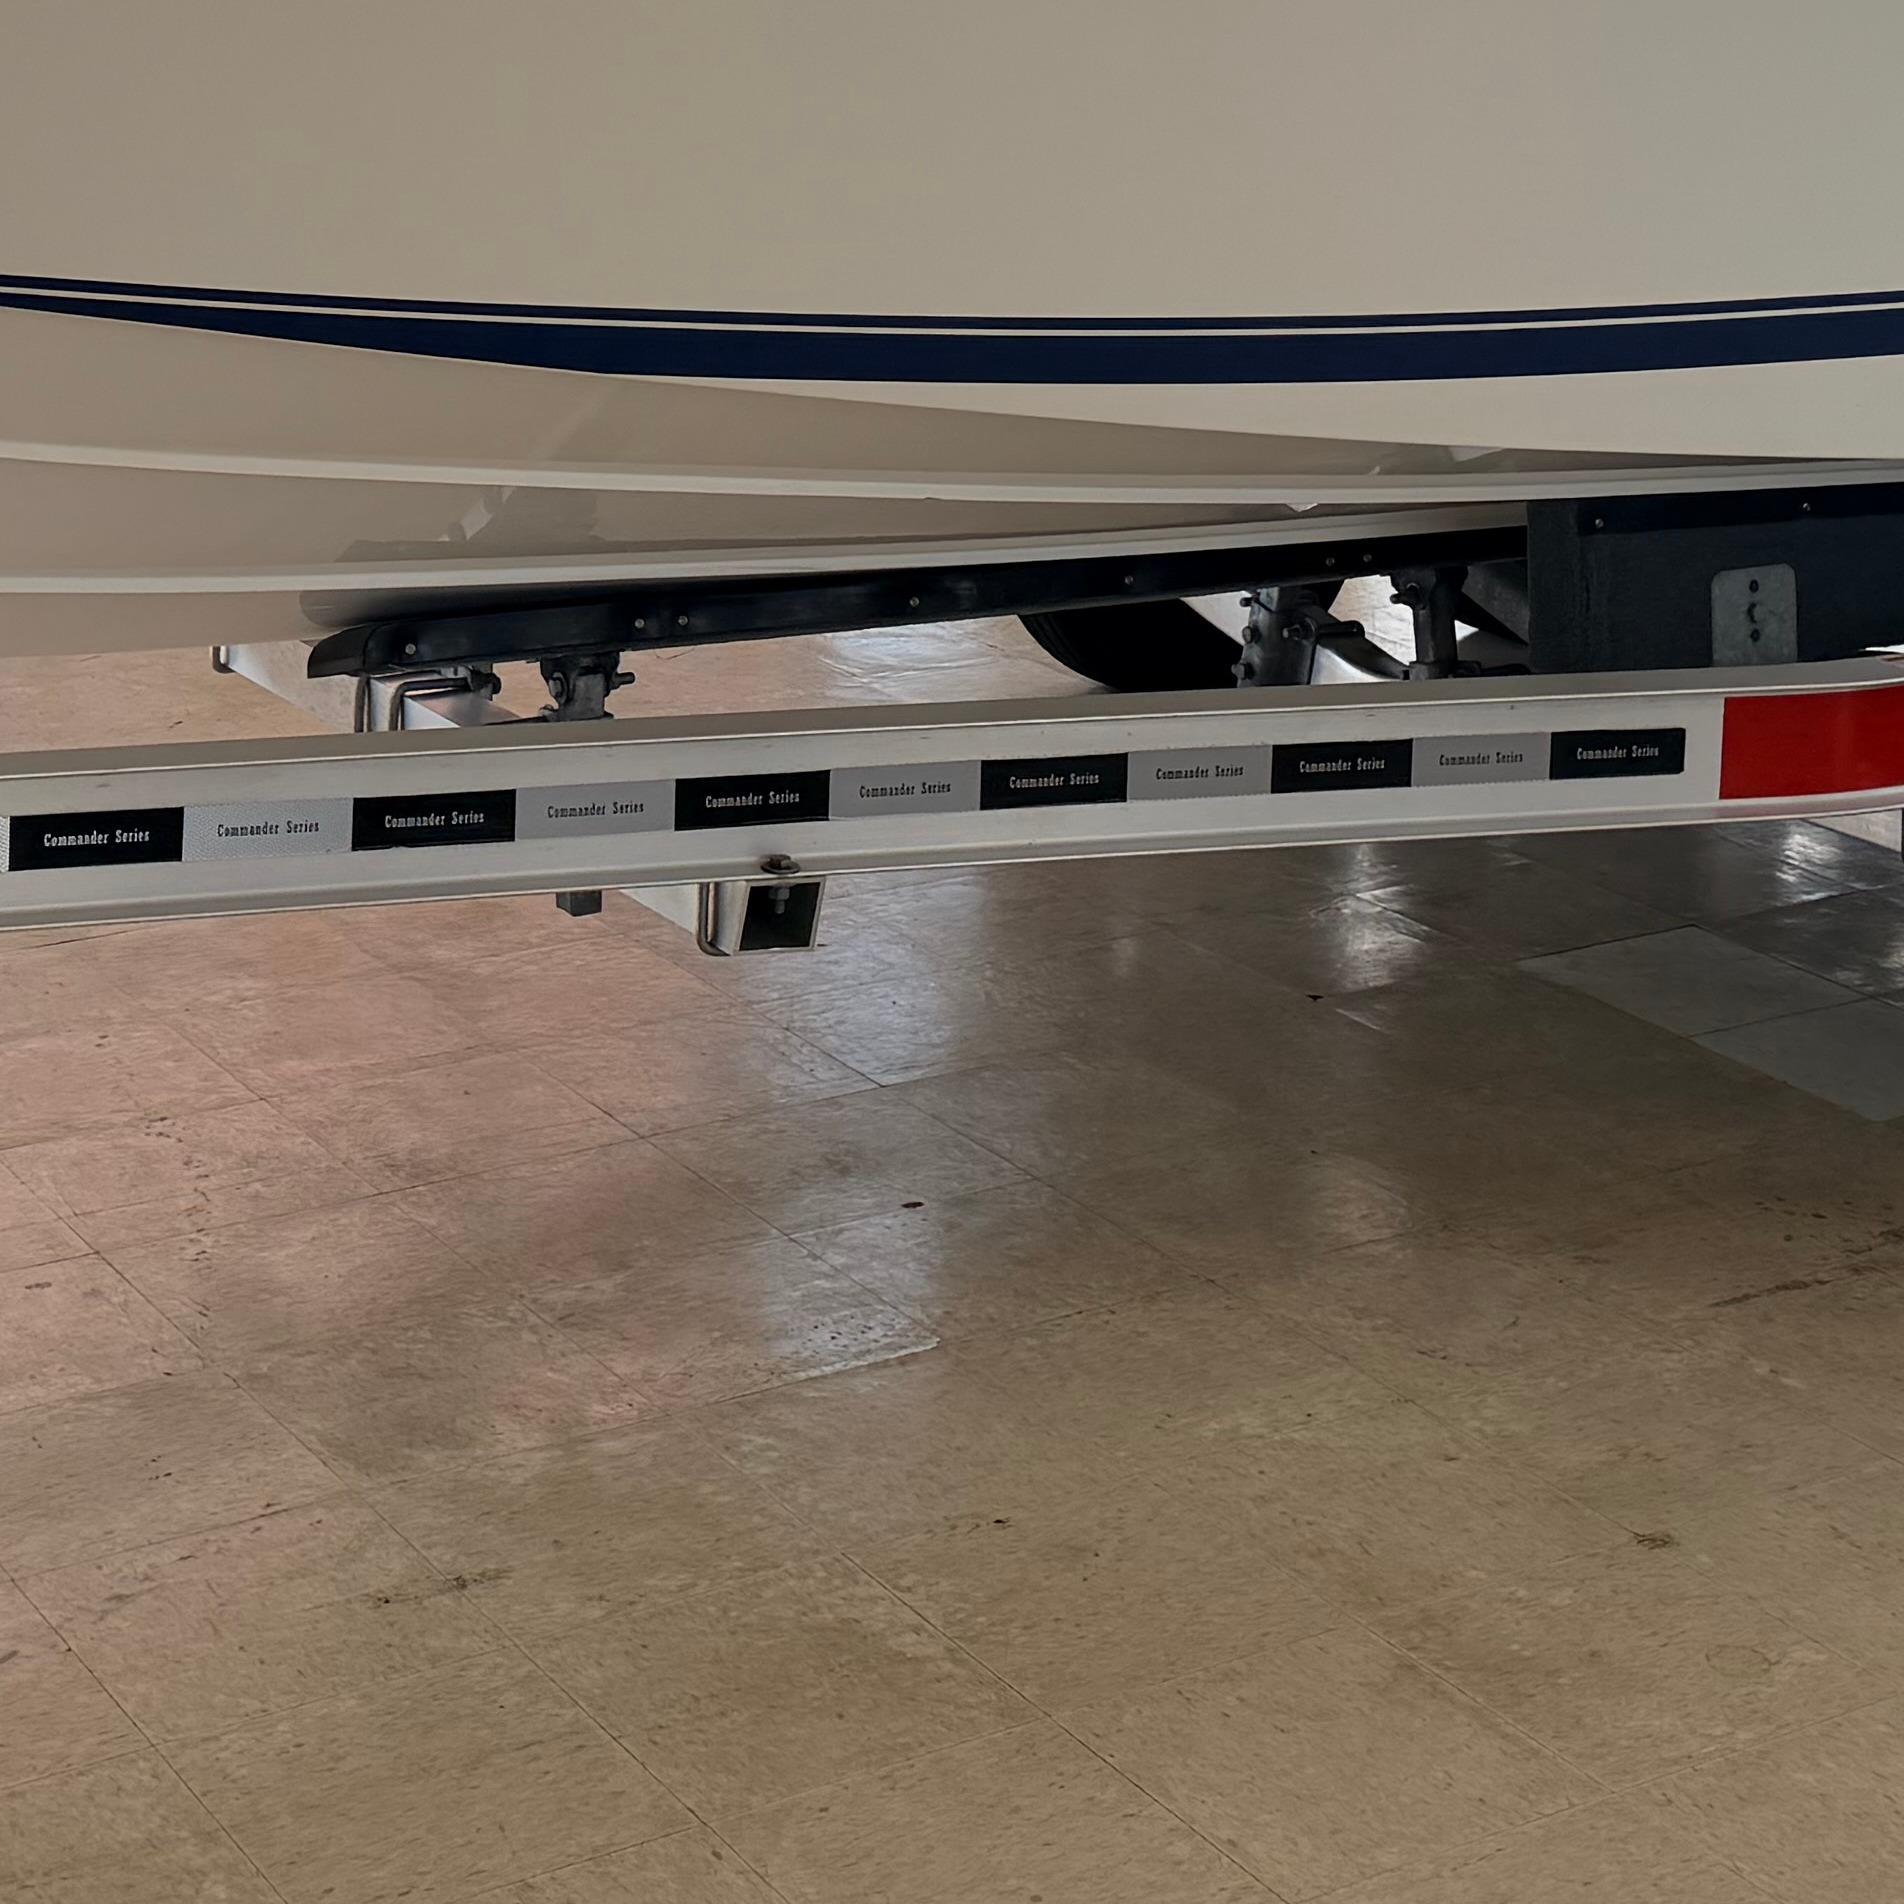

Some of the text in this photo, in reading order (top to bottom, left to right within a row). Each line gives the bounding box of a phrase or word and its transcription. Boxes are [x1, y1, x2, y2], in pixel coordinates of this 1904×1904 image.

[1439, 749, 1524, 767] Commander Series
[1577, 744, 1659, 761] Commander Series
[1156, 763, 1244, 781] Commander Series
[1299, 756, 1385, 774] Commander Series
[1010, 772, 1100, 790] Commander Series
[706, 790, 800, 808] Commander Series
[859, 781, 951, 800] Commander Series
[548, 801, 644, 819] Commander Series
[217, 818, 319, 837] Commander Series
[385, 810, 484, 829] Commander Series
[44, 828, 150, 847] Commander Series
